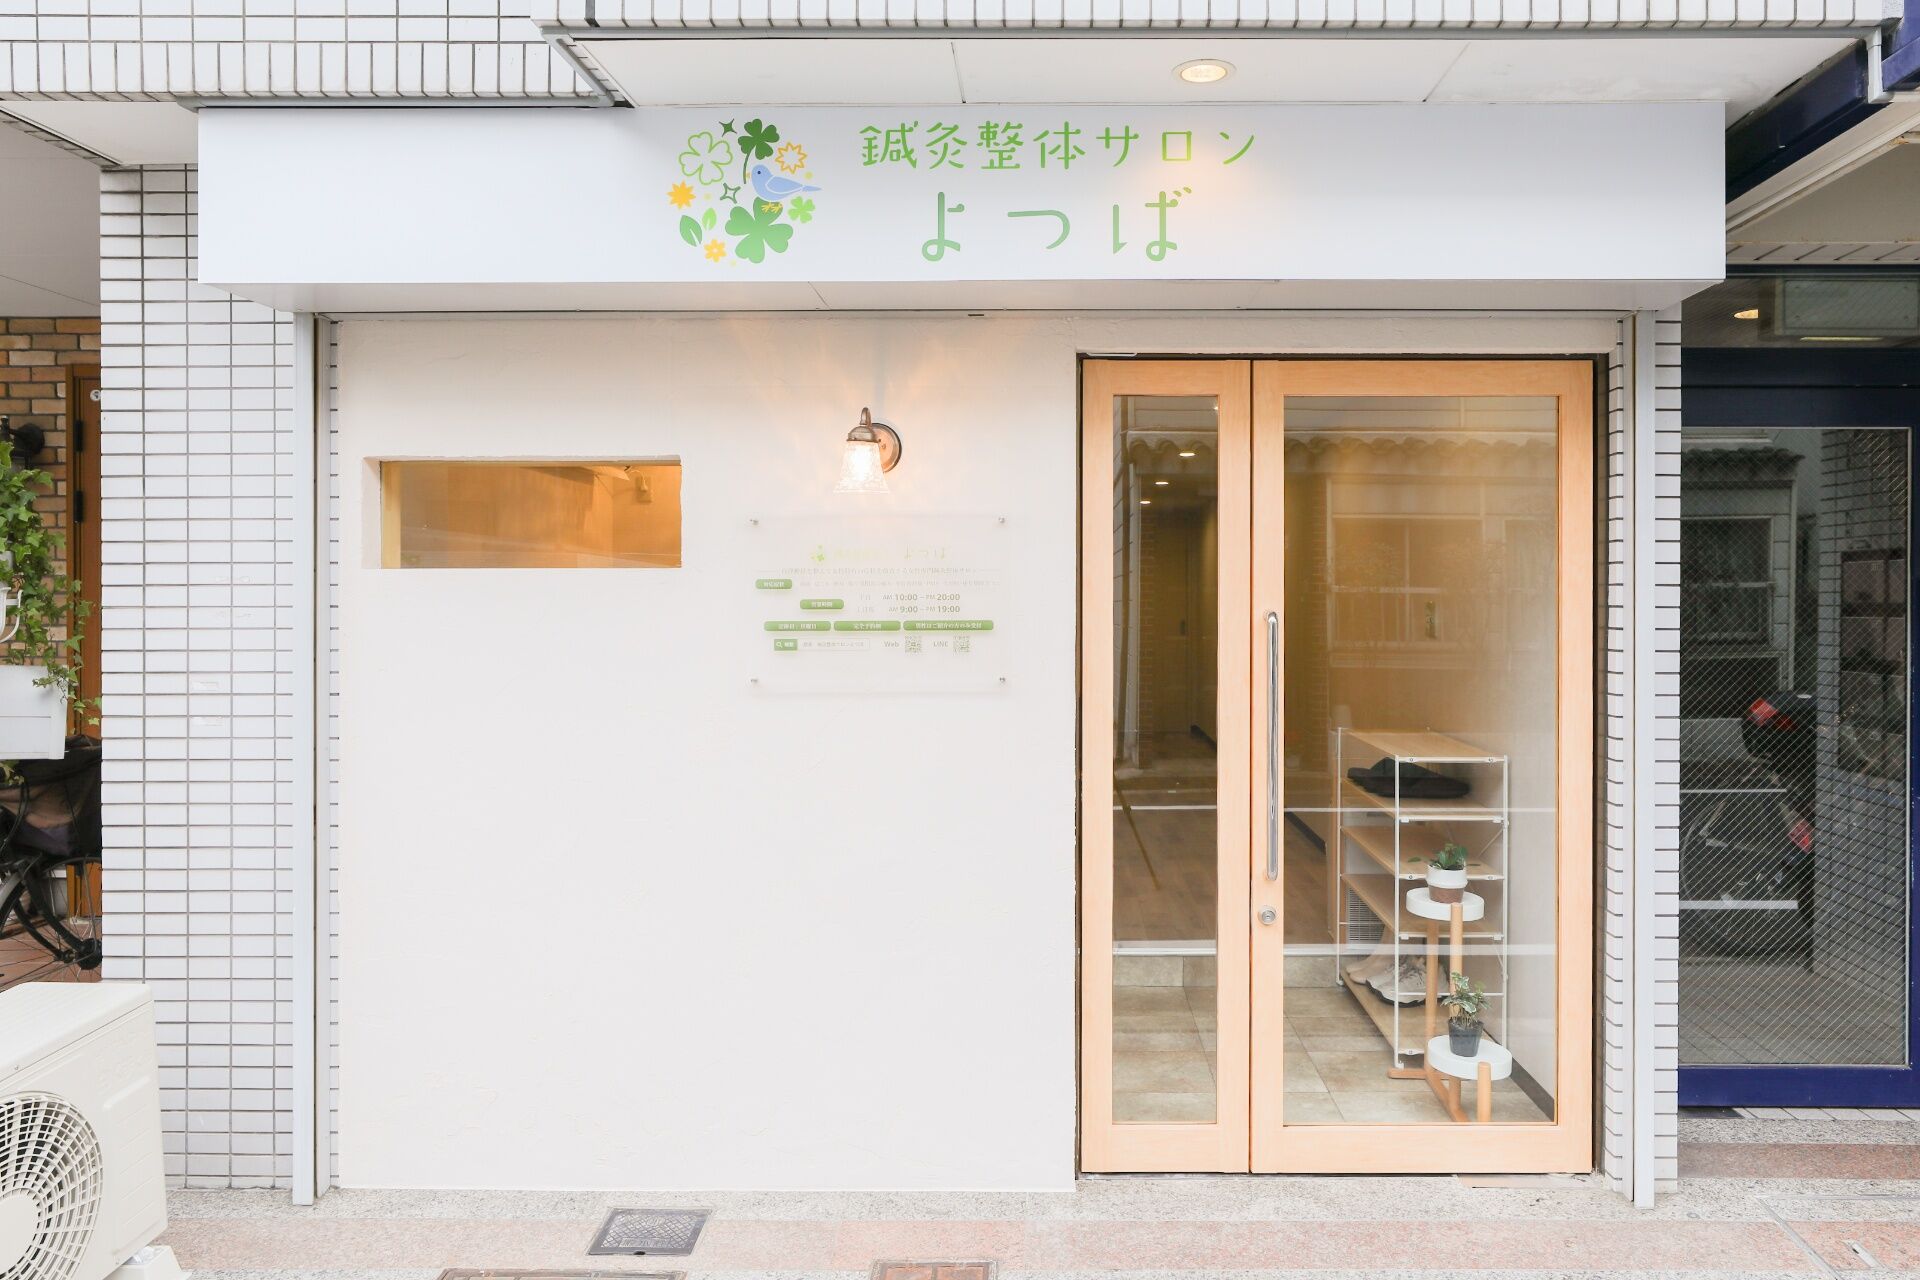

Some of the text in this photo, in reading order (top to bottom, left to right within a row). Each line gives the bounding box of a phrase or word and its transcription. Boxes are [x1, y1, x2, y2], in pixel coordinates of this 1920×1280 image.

[860, 121, 1254, 169] 鍼灸整体サロン
[922, 187, 1192, 262] よつば
[895, 593, 918, 601] 10:00
[936, 593, 960, 601] 20:00
[899, 605, 918, 613] 9:00
[938, 605, 960, 613] 19:00
